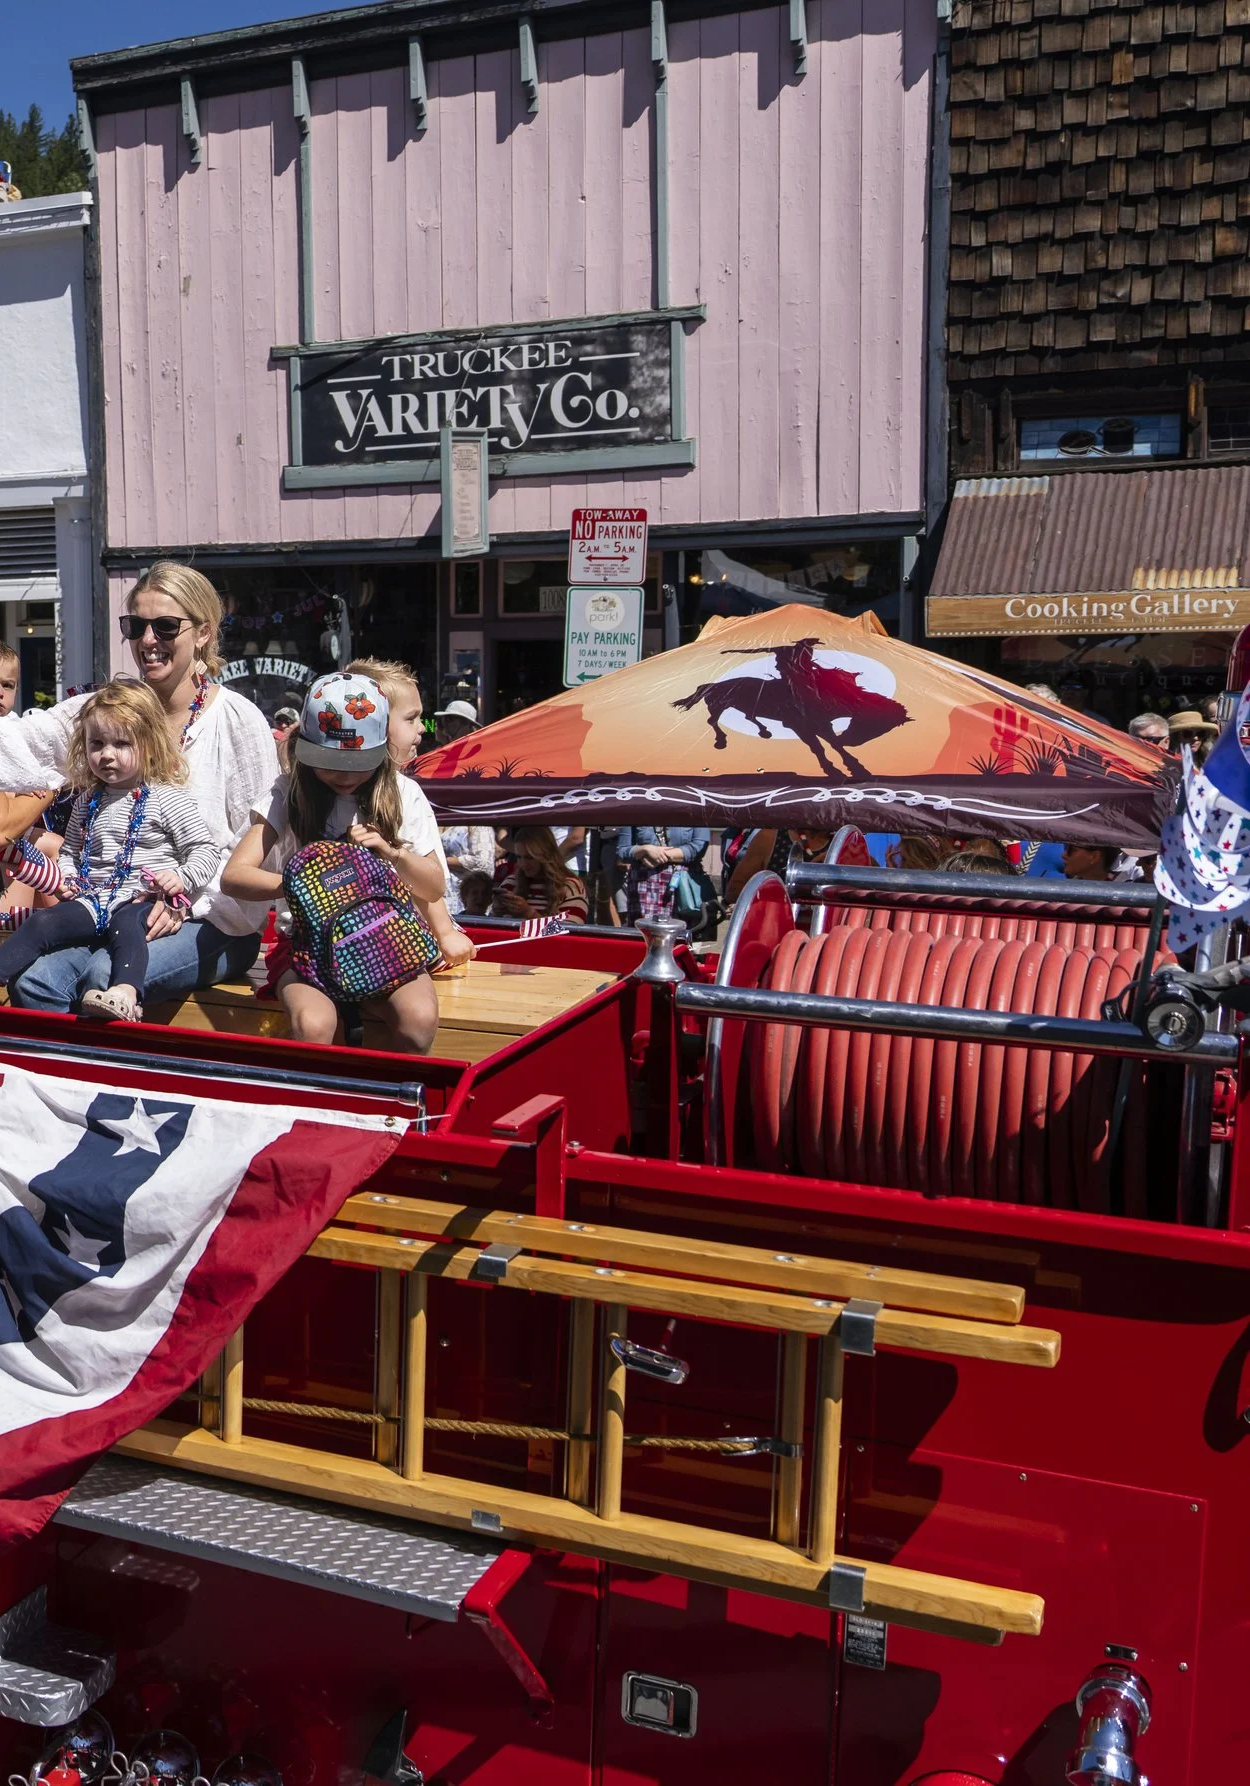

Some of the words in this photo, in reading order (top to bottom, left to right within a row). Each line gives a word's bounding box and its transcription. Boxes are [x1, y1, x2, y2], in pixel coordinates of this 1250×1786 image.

[381, 340, 572, 381] TRUCKEE
[579, 510, 640, 520] TOW-AWAY
[575, 520, 593, 539] NO
[598, 525, 643, 540] PARKING
[1004, 596, 1127, 620] Cooking
[1130, 593, 1239, 618] Gallery
[589, 612, 619, 624] park!
[570, 632, 590, 645] PAY
[594, 632, 636, 645] PARKING
[578, 649, 587, 657] 10
[587, 649, 598, 657] AM
[600, 649, 607, 657] to
[610, 649, 615, 657] 6
[616, 649, 627, 657] PM
[577, 660, 582, 668] 7
